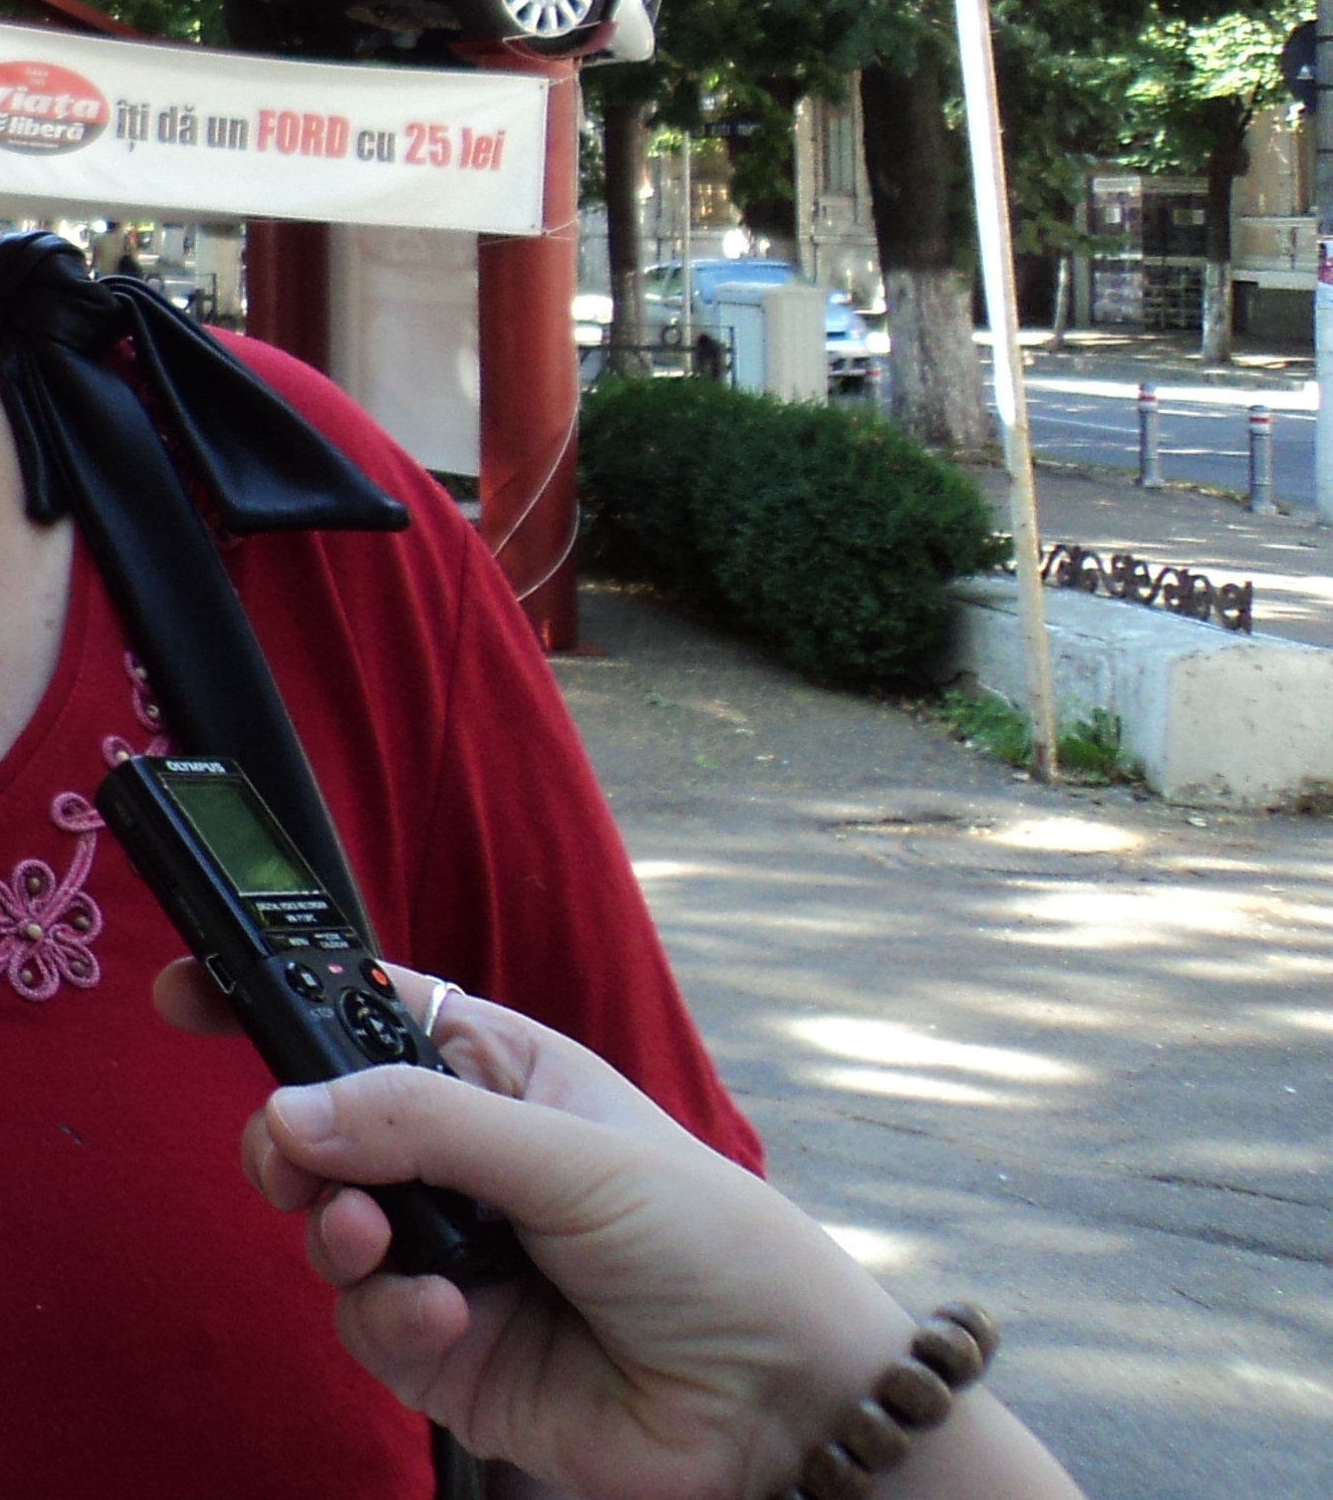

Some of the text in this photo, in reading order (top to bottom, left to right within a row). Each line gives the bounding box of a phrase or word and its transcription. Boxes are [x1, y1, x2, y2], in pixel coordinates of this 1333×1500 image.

[157, 103, 199, 146] dă
[207, 115, 249, 151] un
[257, 109, 350, 159] FORD
[357, 129, 396, 163] cu
[404, 122, 452, 168] 25
[459, 127, 506, 171] lei
[165, 760, 226, 774] OLYMPUS
